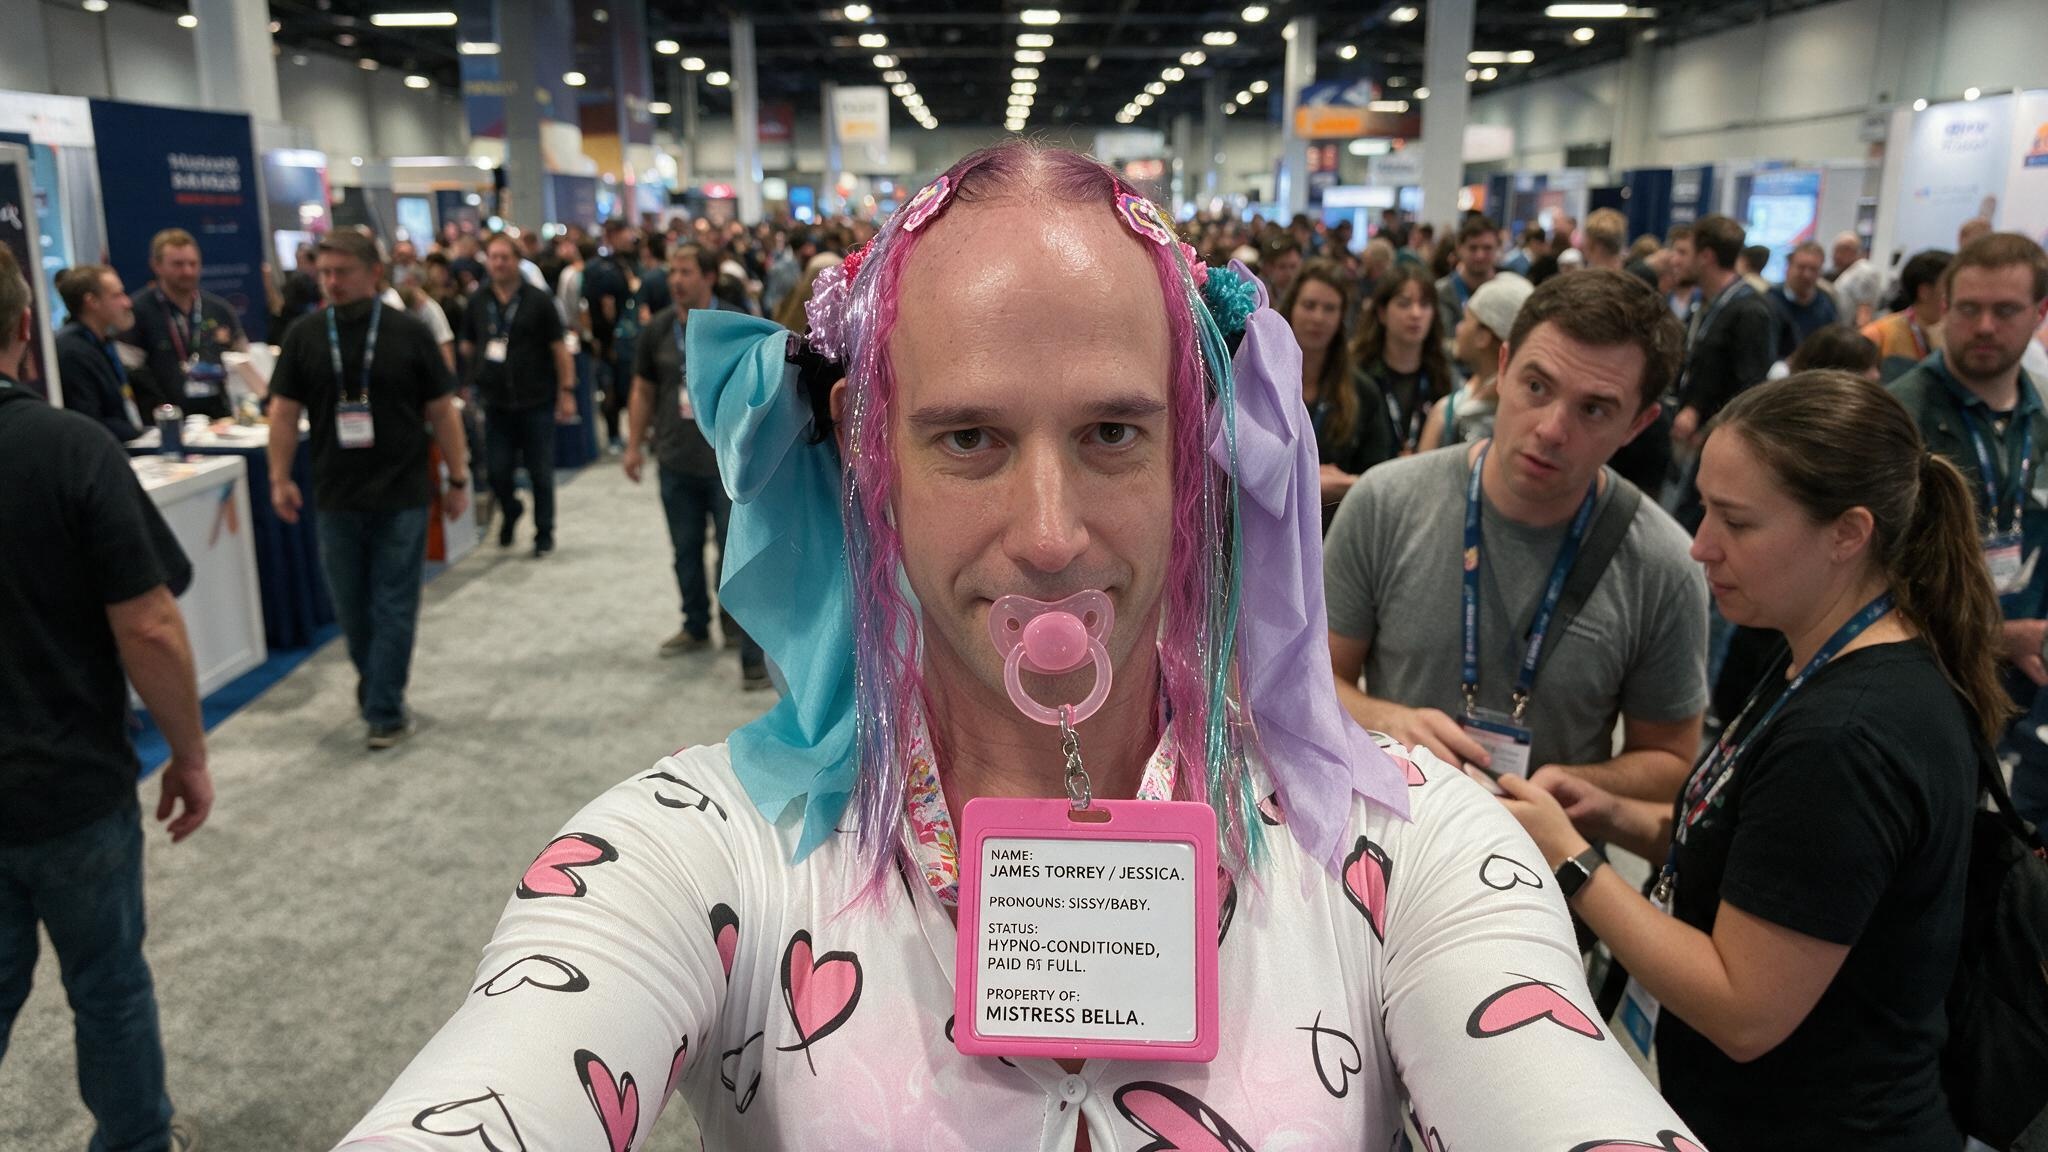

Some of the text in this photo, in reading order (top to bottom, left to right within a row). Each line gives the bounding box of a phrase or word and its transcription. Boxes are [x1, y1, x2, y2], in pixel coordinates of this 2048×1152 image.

[992, 849, 1032, 860] NAME:
[990, 865, 1184, 880] JAMES TORREY / JESSICA.
[990, 897, 1149, 910] PRONOUNS: SISSY/BABY.
[989, 923, 1037, 934] STATUS:
[989, 939, 1159, 958] HYPNO-CONDITIONED,
[988, 958, 1021, 970] PAID
[1048, 959, 1085, 972] FULL.
[987, 988, 1079, 1001] PROPERTY OF:
[987, 1006, 1144, 1025] MISTRESS BELLA.
